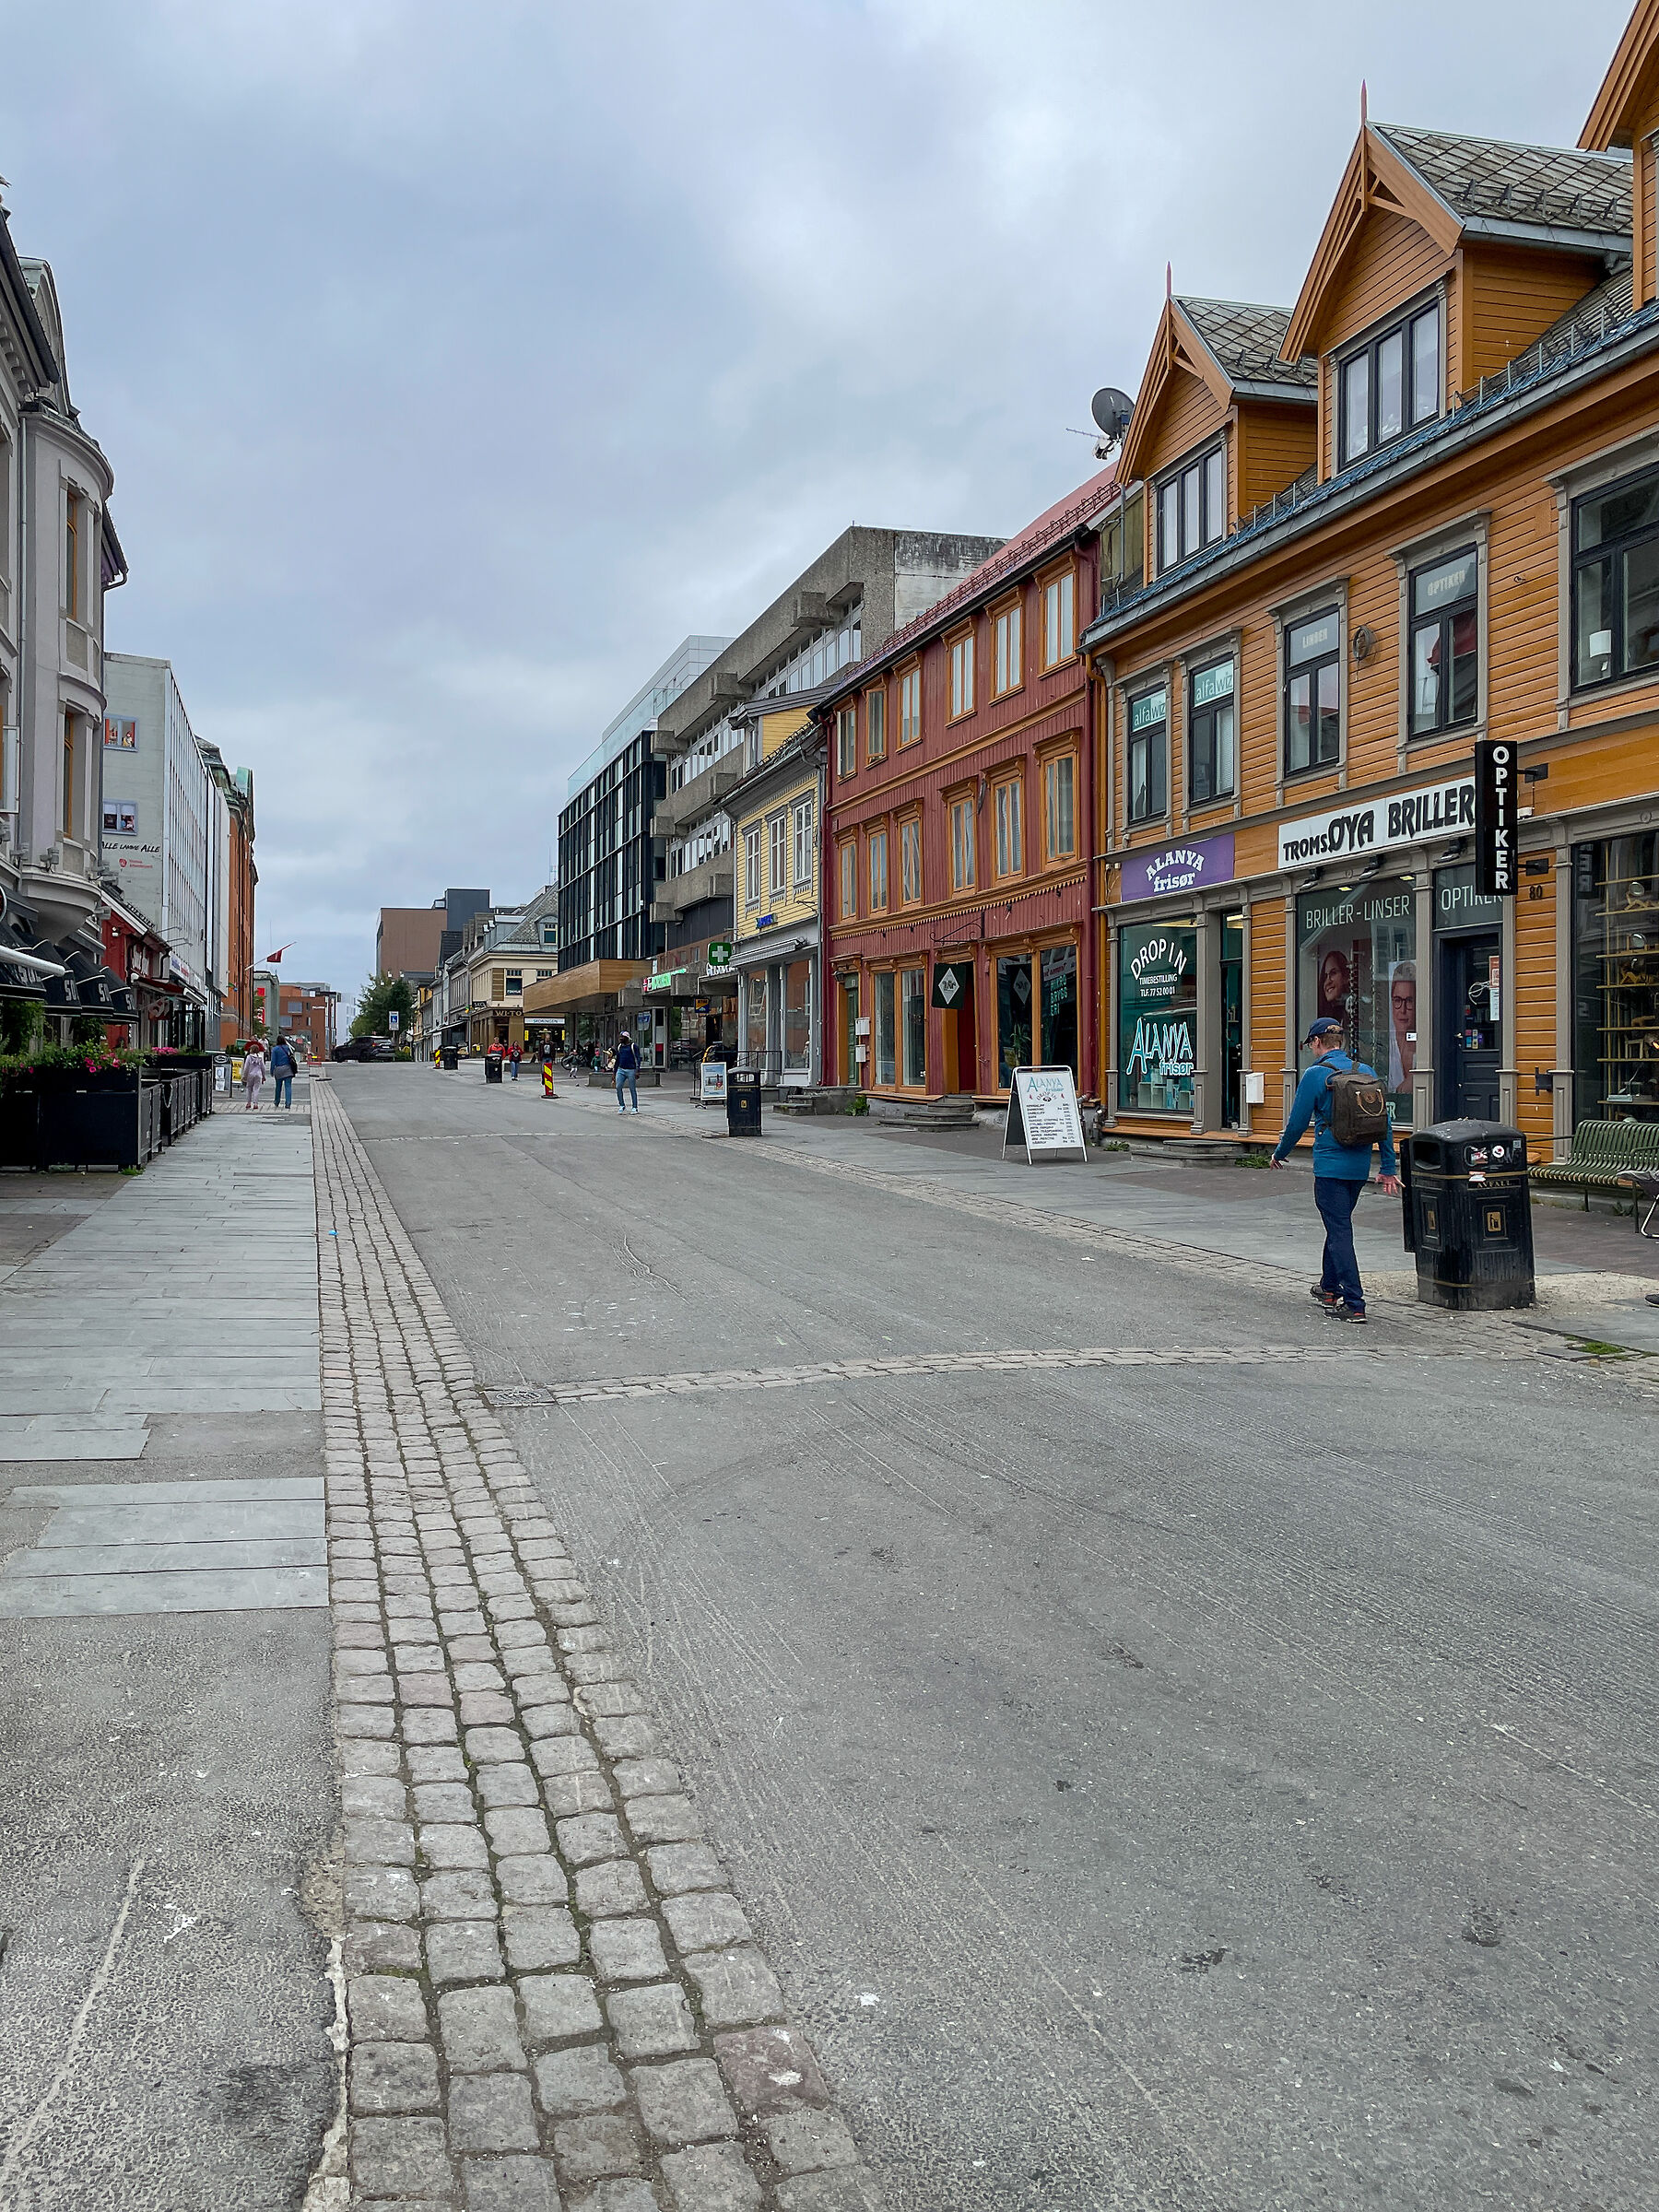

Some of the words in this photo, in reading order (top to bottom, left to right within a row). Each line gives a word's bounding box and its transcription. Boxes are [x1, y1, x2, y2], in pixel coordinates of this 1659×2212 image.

[1492, 746, 1510, 889] OPTIKER
[1146, 850, 1205, 881] ALANYA
[1154, 873, 1195, 892] frisør
[1529, 885, 1543, 900] 80
[1306, 904, 1354, 930] BRILLER
[1364, 895, 1410, 922] LINSER
[1131, 938, 1167, 981] DROP
[1168, 941, 1187, 976] IN
[1139, 973, 1178, 985] TIMEBESTILLING
[1126, 1017, 1194, 1075] ALANYA
[1159, 1059, 1194, 1076] frisør
[1027, 1077, 1064, 1092] ALANYA
